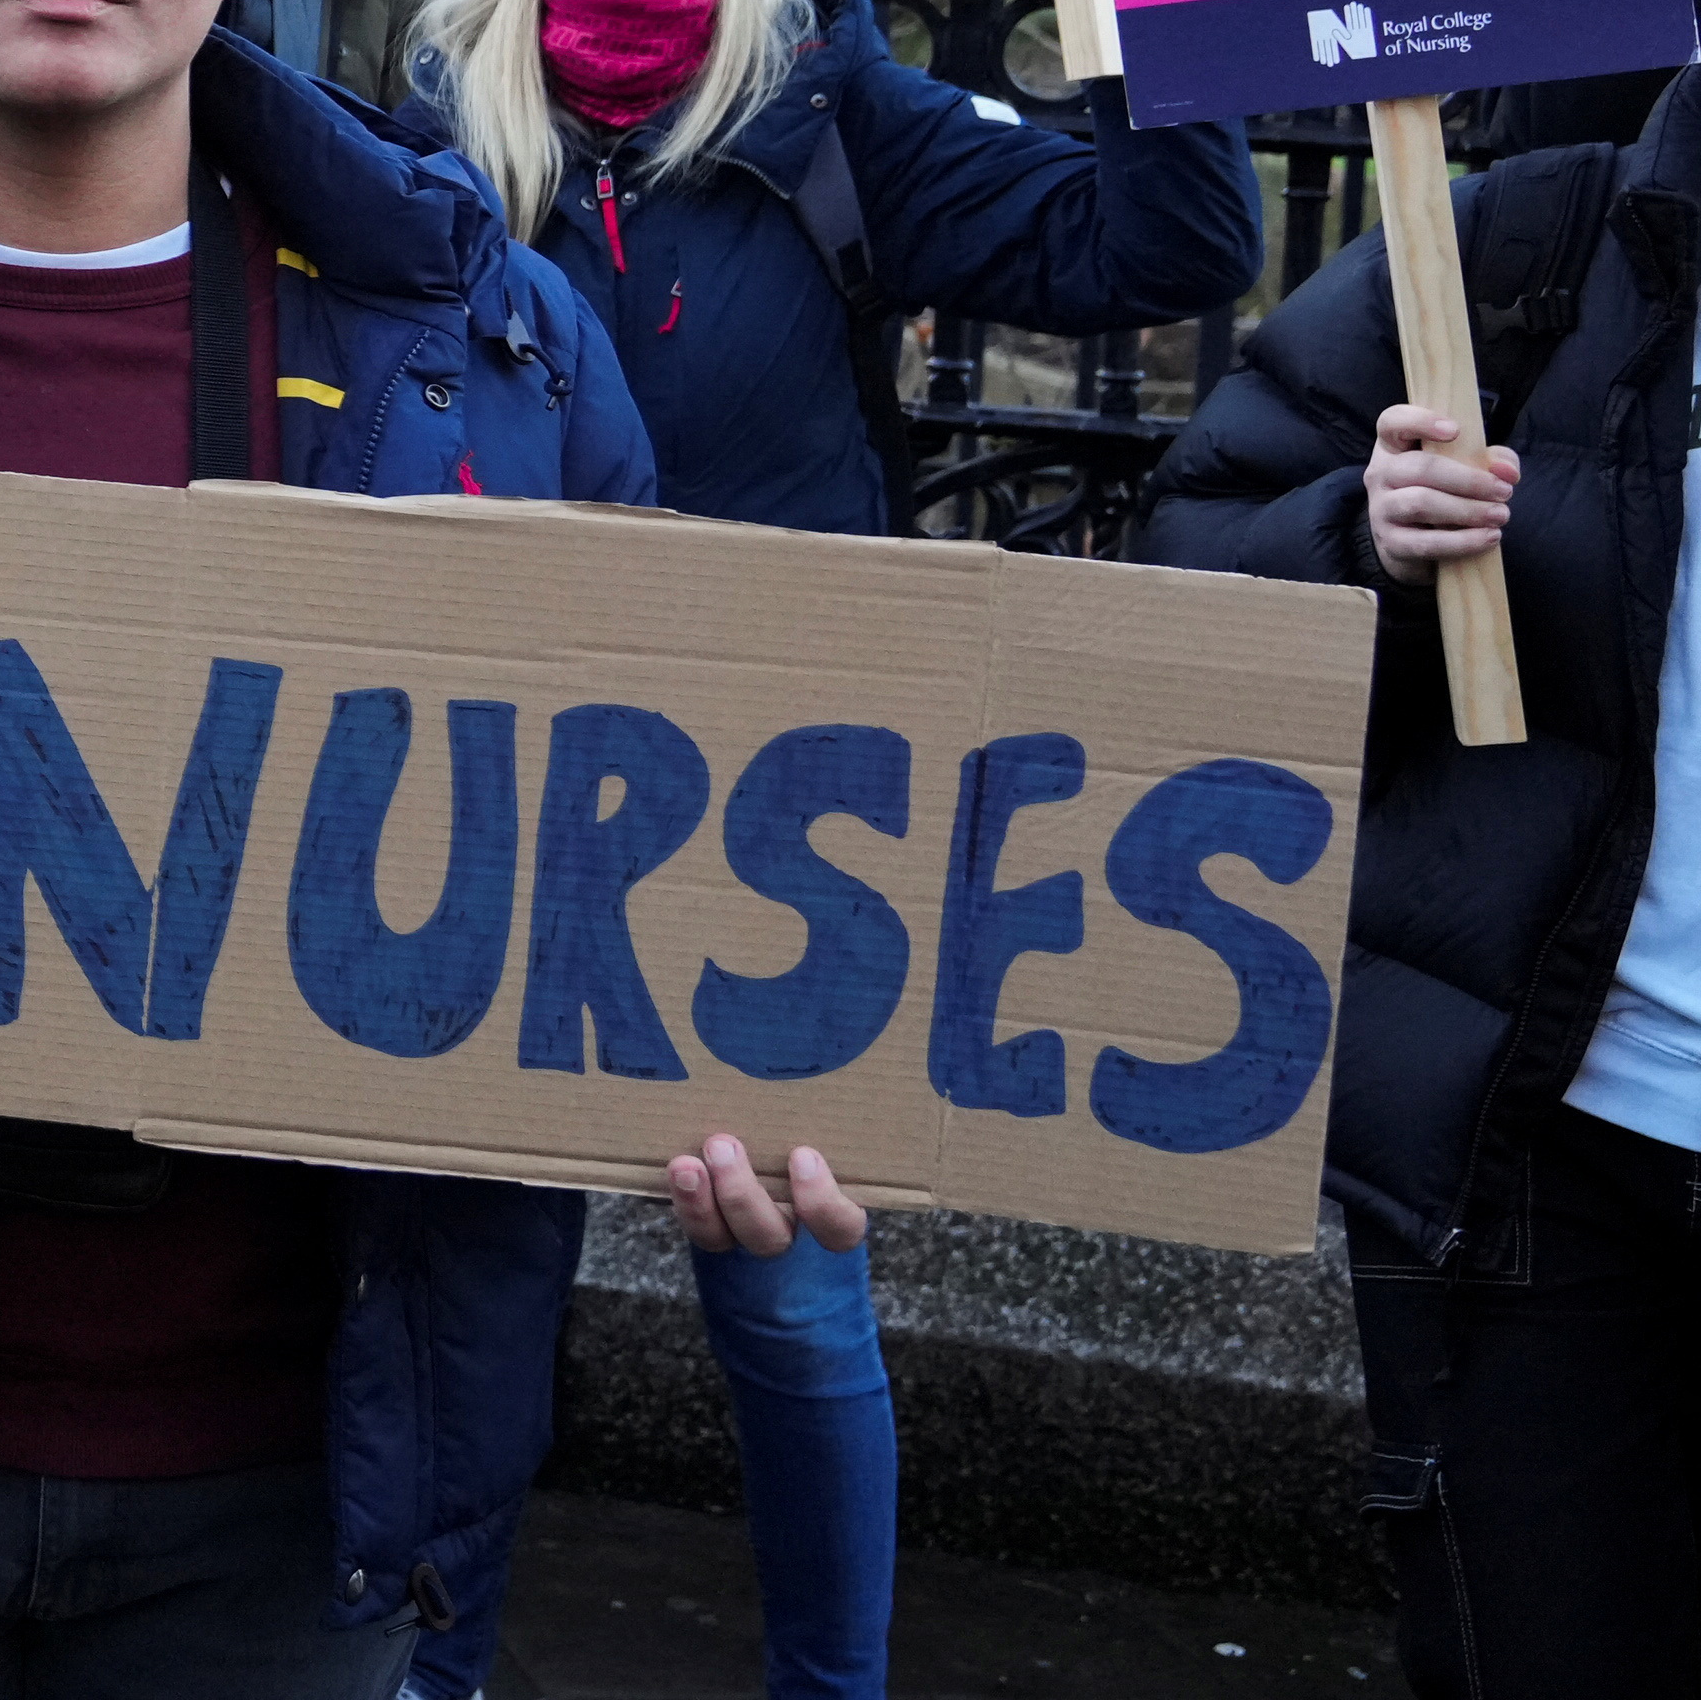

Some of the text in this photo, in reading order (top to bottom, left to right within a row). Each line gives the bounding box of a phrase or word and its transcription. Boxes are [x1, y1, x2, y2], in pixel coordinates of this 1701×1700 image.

[1382, 11, 1492, 39] Royal College
[1384, 34, 1471, 56] of Nursing
